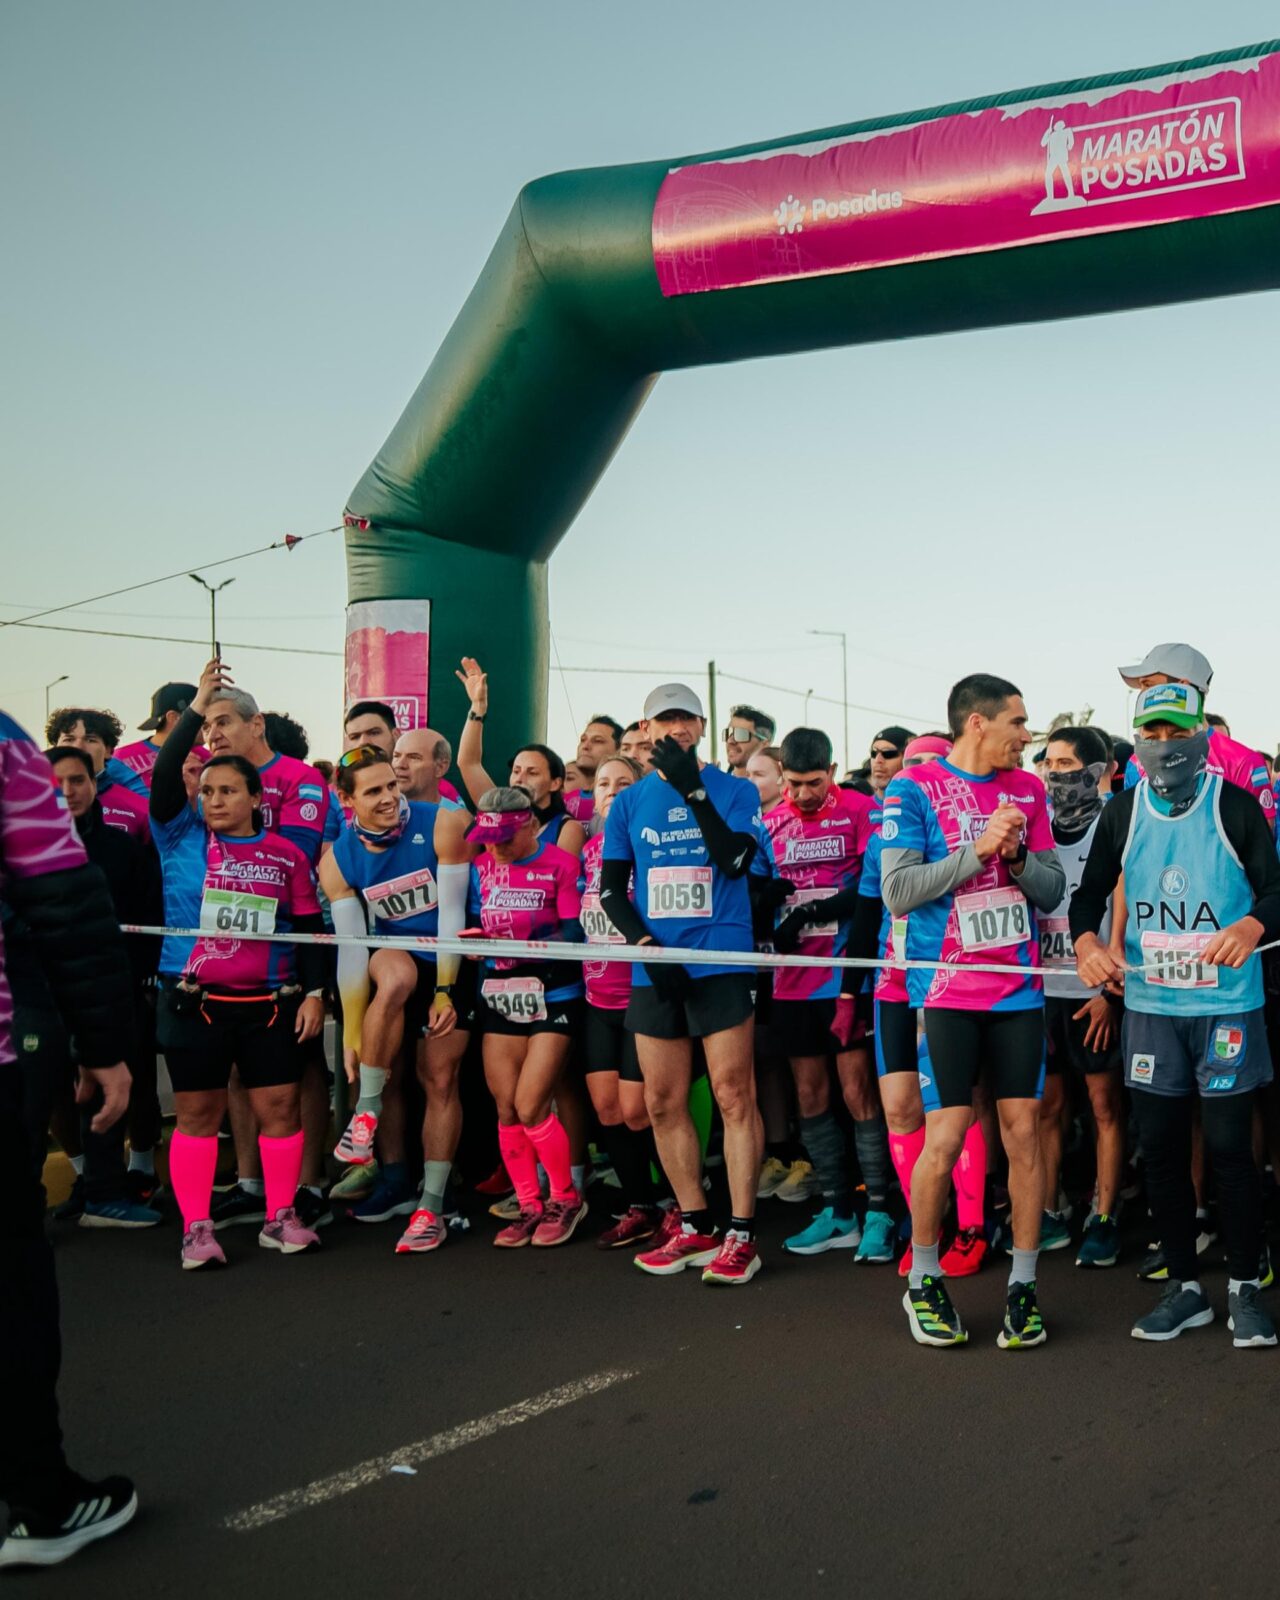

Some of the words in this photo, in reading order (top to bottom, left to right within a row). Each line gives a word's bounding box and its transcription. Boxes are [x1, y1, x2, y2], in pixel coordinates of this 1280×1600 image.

[1081, 110, 1224, 163] MARATÓN
[1081, 143, 1227, 194] POSADAS
[812, 188, 902, 221] Posadas
[796, 847, 840, 860] POSADAS
[797, 838, 839, 852] MARATÓN
[378, 884, 430, 917] 1077
[653, 884, 706, 911] 1059
[216, 906, 260, 933] 641
[968, 904, 1024, 943] 1078
[1136, 901, 1221, 931] PNA
[1154, 950, 1203, 981] 1151
[488, 993, 539, 1017] 1349
